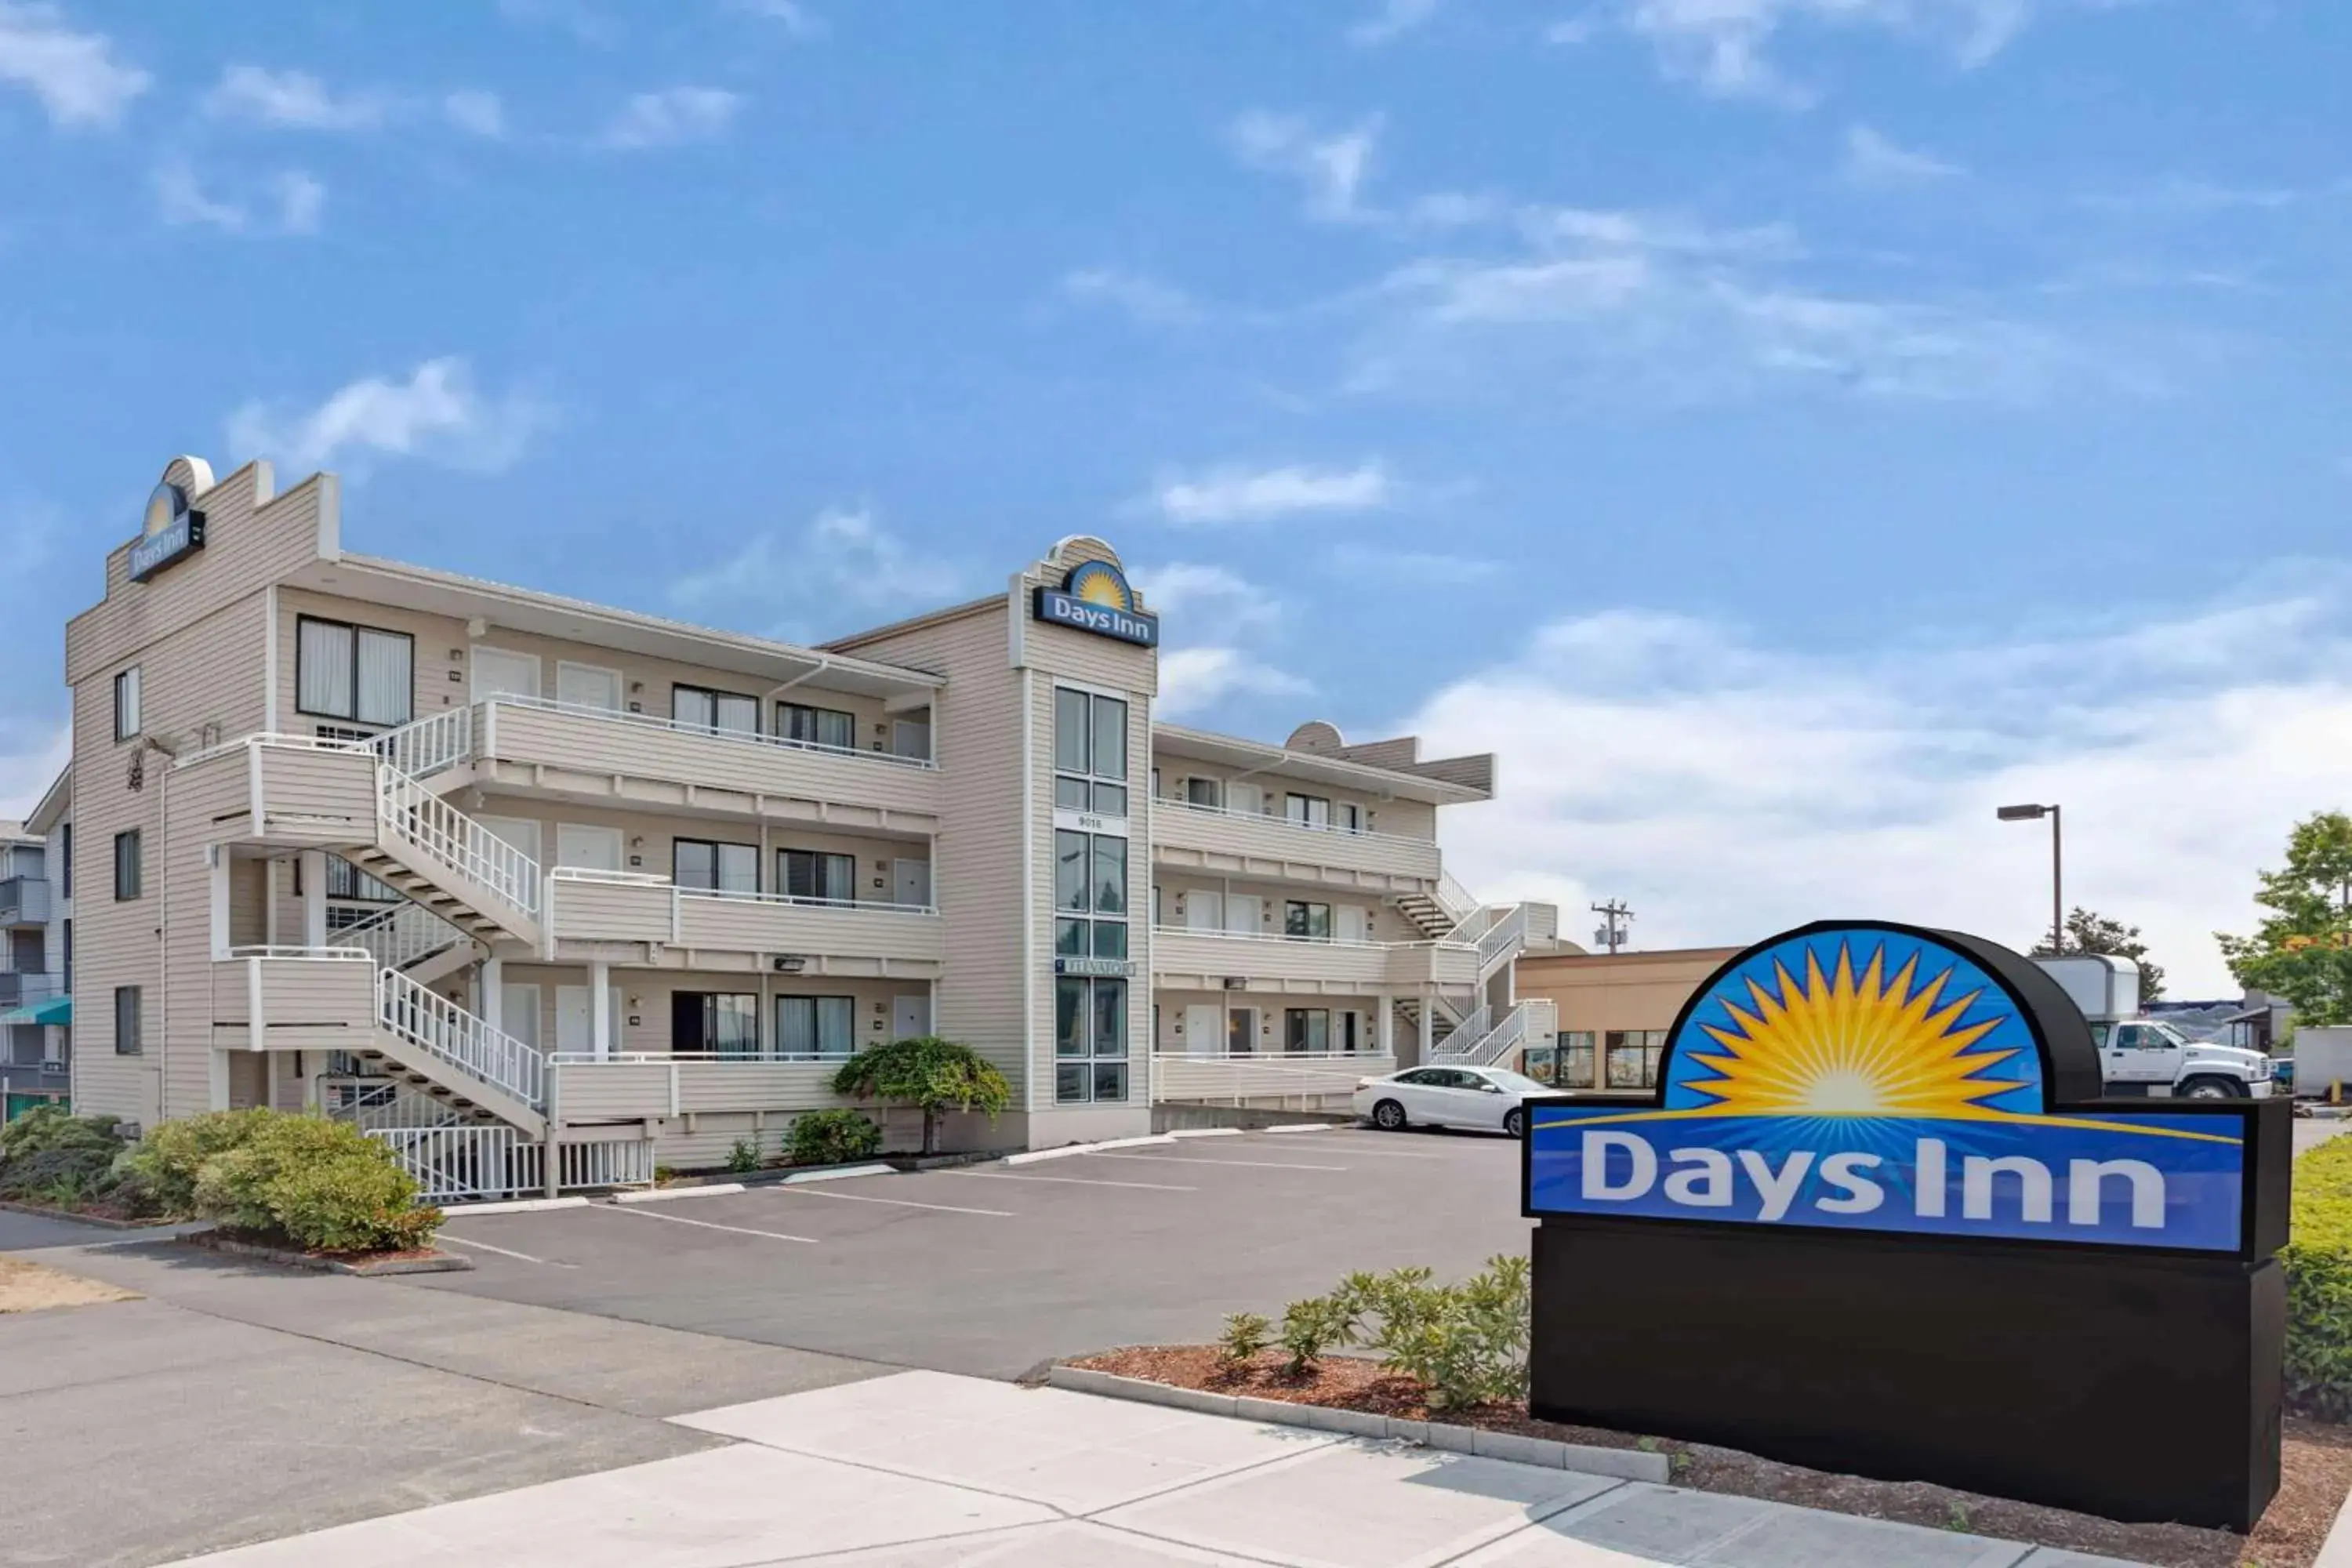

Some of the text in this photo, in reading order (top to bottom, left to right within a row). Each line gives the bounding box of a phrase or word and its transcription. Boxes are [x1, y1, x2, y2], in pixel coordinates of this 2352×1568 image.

[1054, 597, 1149, 639] Days Inn
[1581, 1130, 2165, 1229] Days Inn
